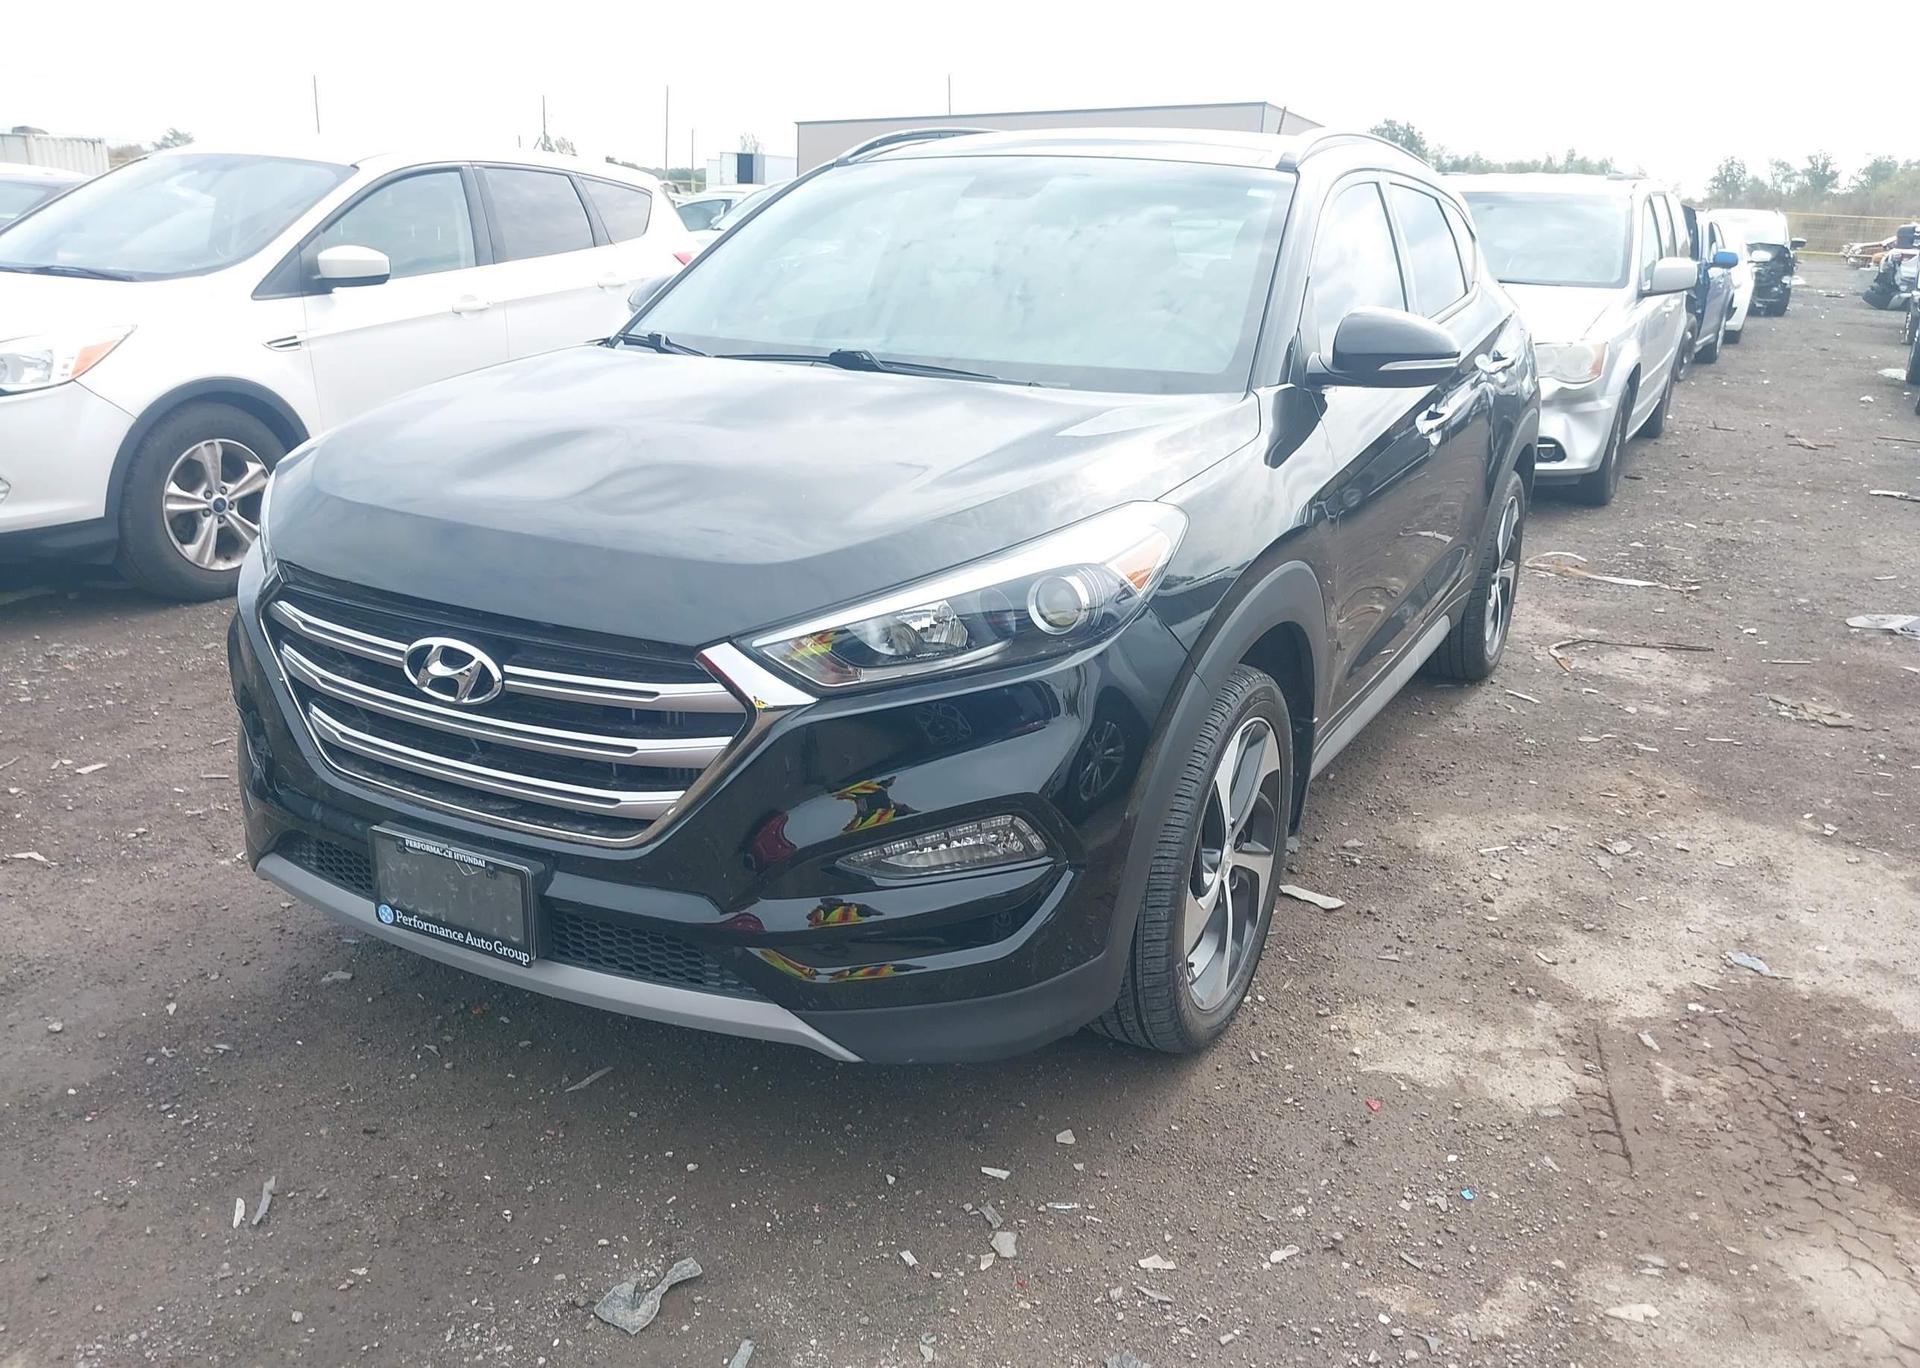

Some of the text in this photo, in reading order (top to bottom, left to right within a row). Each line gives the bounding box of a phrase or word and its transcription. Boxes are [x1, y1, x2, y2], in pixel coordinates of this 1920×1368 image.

[453, 851, 486, 868] HYUNDAI
[395, 909, 530, 966] Performance Auto Group
